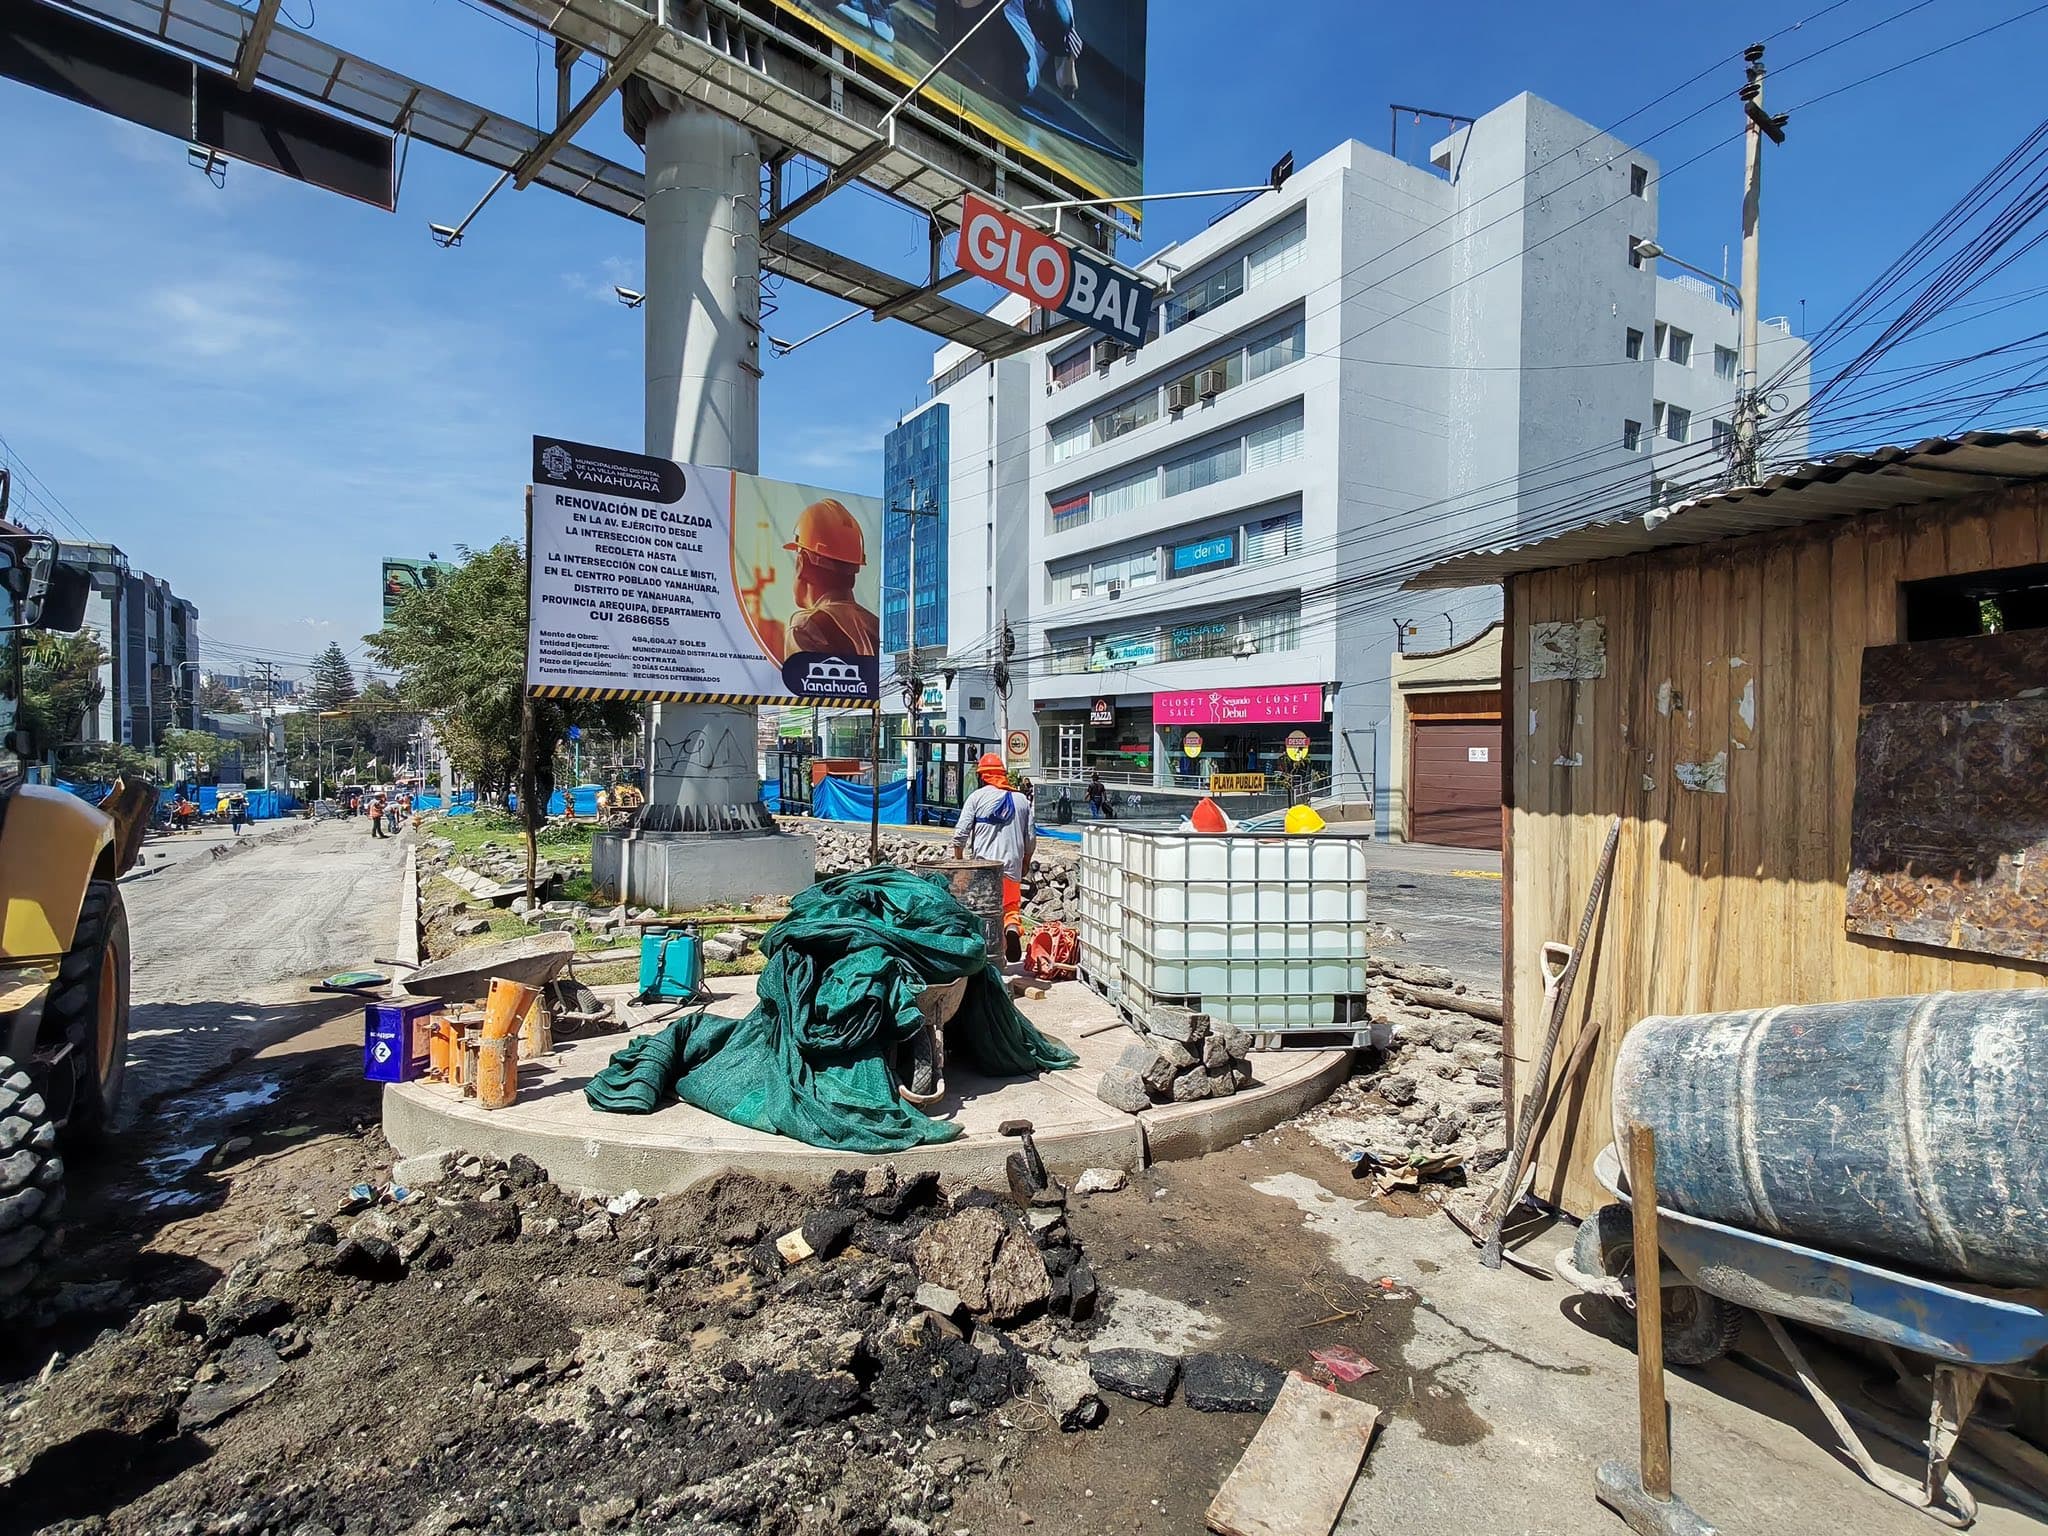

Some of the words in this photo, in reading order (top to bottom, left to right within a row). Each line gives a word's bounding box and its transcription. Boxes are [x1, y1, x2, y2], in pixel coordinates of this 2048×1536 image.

[968, 213, 1141, 337] GLOBAL
[575, 459, 629, 472] MUNICIPALIDAD
[630, 467, 660, 477] DISTRITAL
[597, 467, 616, 475] VILLA
[617, 470, 650, 481] HERMOSA
[574, 471, 660, 493] YANAHUARA
[555, 494, 638, 518] RENOVACIÓN
[641, 508, 658, 520] DE
[660, 511, 713, 530] CALZADA
[573, 513, 587, 523] EN
[589, 515, 602, 525] LA
[604, 518, 619, 528] AV.
[621, 520, 666, 534] EJÉRCITO
[668, 527, 698, 539] DESDE
[565, 526, 579, 536] LA
[581, 528, 652, 546] INTERSECCIÓN
[654, 538, 673, 549] CON
[675, 542, 703, 553] CALLE
[595, 544, 645, 558] RECOLETA
[646, 551, 677, 563] HASTA
[548, 552, 562, 562] LA
[564, 554, 636, 571] INTERSECCIÓN
[638, 563, 658, 574] CON
[660, 566, 689, 578] CALLE
[690, 569, 717, 581] MISTI,
[544, 566, 558, 576] EN
[561, 568, 573, 578] EL
[575, 570, 616, 582] CENTRO
[618, 574, 662, 587] POBLADO
[664, 580, 720, 595] YANAHUARA,
[574, 583, 619, 596] DISTRITO
[621, 589, 635, 598] DE
[637, 590, 694, 605] YANAHUARA,
[541, 594, 596, 608] PROVINCIA
[599, 600, 649, 614] AREQUIPA,
[651, 605, 721, 620] DEPARTAMENTO
[589, 611, 613, 622] CUI
[617, 613, 670, 627] 2686655
[540, 630, 565, 639] Monto
[566, 632, 576, 640] de
[577, 632, 599, 641] Obra:
[679, 640, 707, 648] SOLES
[540, 640, 569, 649] Entidad
[571, 641, 609, 651] Ejecutora:
[632, 647, 686, 656] MUNICIPALIDAD
[687, 650, 719, 659] DISTRITAL
[728, 653, 768, 662] YANAHUARA
[540, 649, 581, 658] Modalidad
[632, 655, 678, 664] CONTRATA
[540, 658, 562, 666] Plazo
[660, 666, 706, 674] CALENDARIOS
[539, 667, 567, 675] Fuente
[568, 667, 629, 678] financiamiento:
[669, 675, 720, 683] DETERMINADOS
[800, 678, 868, 693] Yanahuara
[1161, 697, 1202, 707] CLOSET
[1222, 696, 1251, 707] Segundo
[1256, 693, 1309, 704] CLOSET
[1090, 711, 1112, 721] PIAZZA
[1170, 707, 1196, 717] SALE
[1222, 706, 1247, 719] Debut
[1266, 704, 1298, 716] SALE
[1213, 775, 1234, 790] PLAYA
